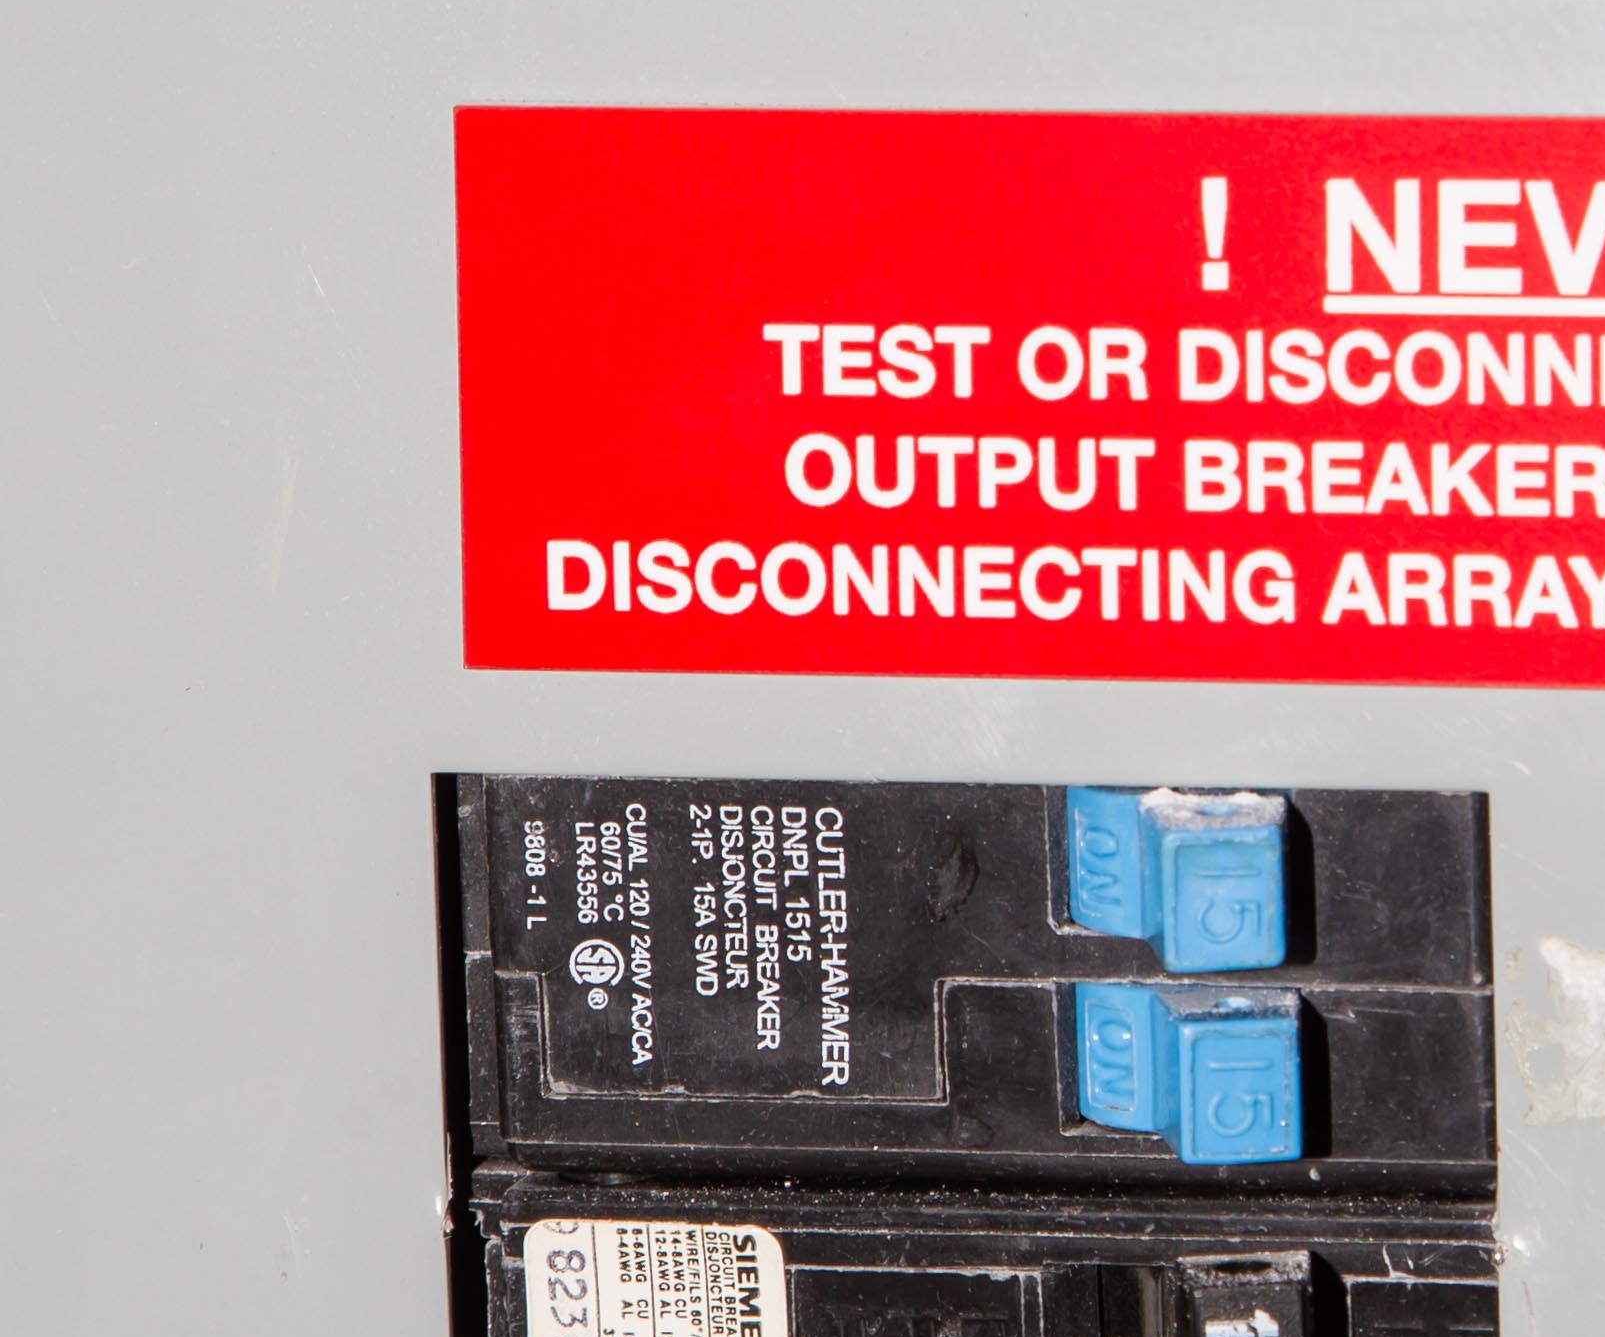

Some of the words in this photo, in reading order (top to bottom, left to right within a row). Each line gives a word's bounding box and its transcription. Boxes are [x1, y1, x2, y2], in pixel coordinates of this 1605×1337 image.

[1200, 176, 1230, 291] !
[762, 323, 991, 399] TEST
[1017, 325, 1149, 401] OR
[784, 432, 1156, 511] OUTPUT
[546, 539, 1296, 625] DISCONNECTING
[524, 820, 546, 877] 9808
[574, 822, 599, 924] LR43556
[599, 821, 623, 886] 60/75
[625, 803, 649, 872] CU/AL
[750, 805, 778, 911] CIRCUIT
[781, 806, 810, 887] DNPL
[1079, 825, 1119, 907] ON
[693, 882, 717, 928] 15A
[719, 805, 749, 989] DISJONCTEUR
[785, 897, 812, 962] 1515
[1194, 868, 1261, 943] 15
[694, 933, 719, 996] SWD
[814, 806, 850, 1086] CUTLER-HAMMER
[754, 924, 781, 1050] BREAKER
[630, 993, 653, 1065] AC/CA
[1089, 1018, 1131, 1096] ON
[1206, 1059, 1272, 1137] 15
[685, 1229, 702, 1304] WIRE/FILS
[705, 1231, 723, 1335] DISJONCTEUR
[718, 1232, 736, 1290] CIRCUIT
